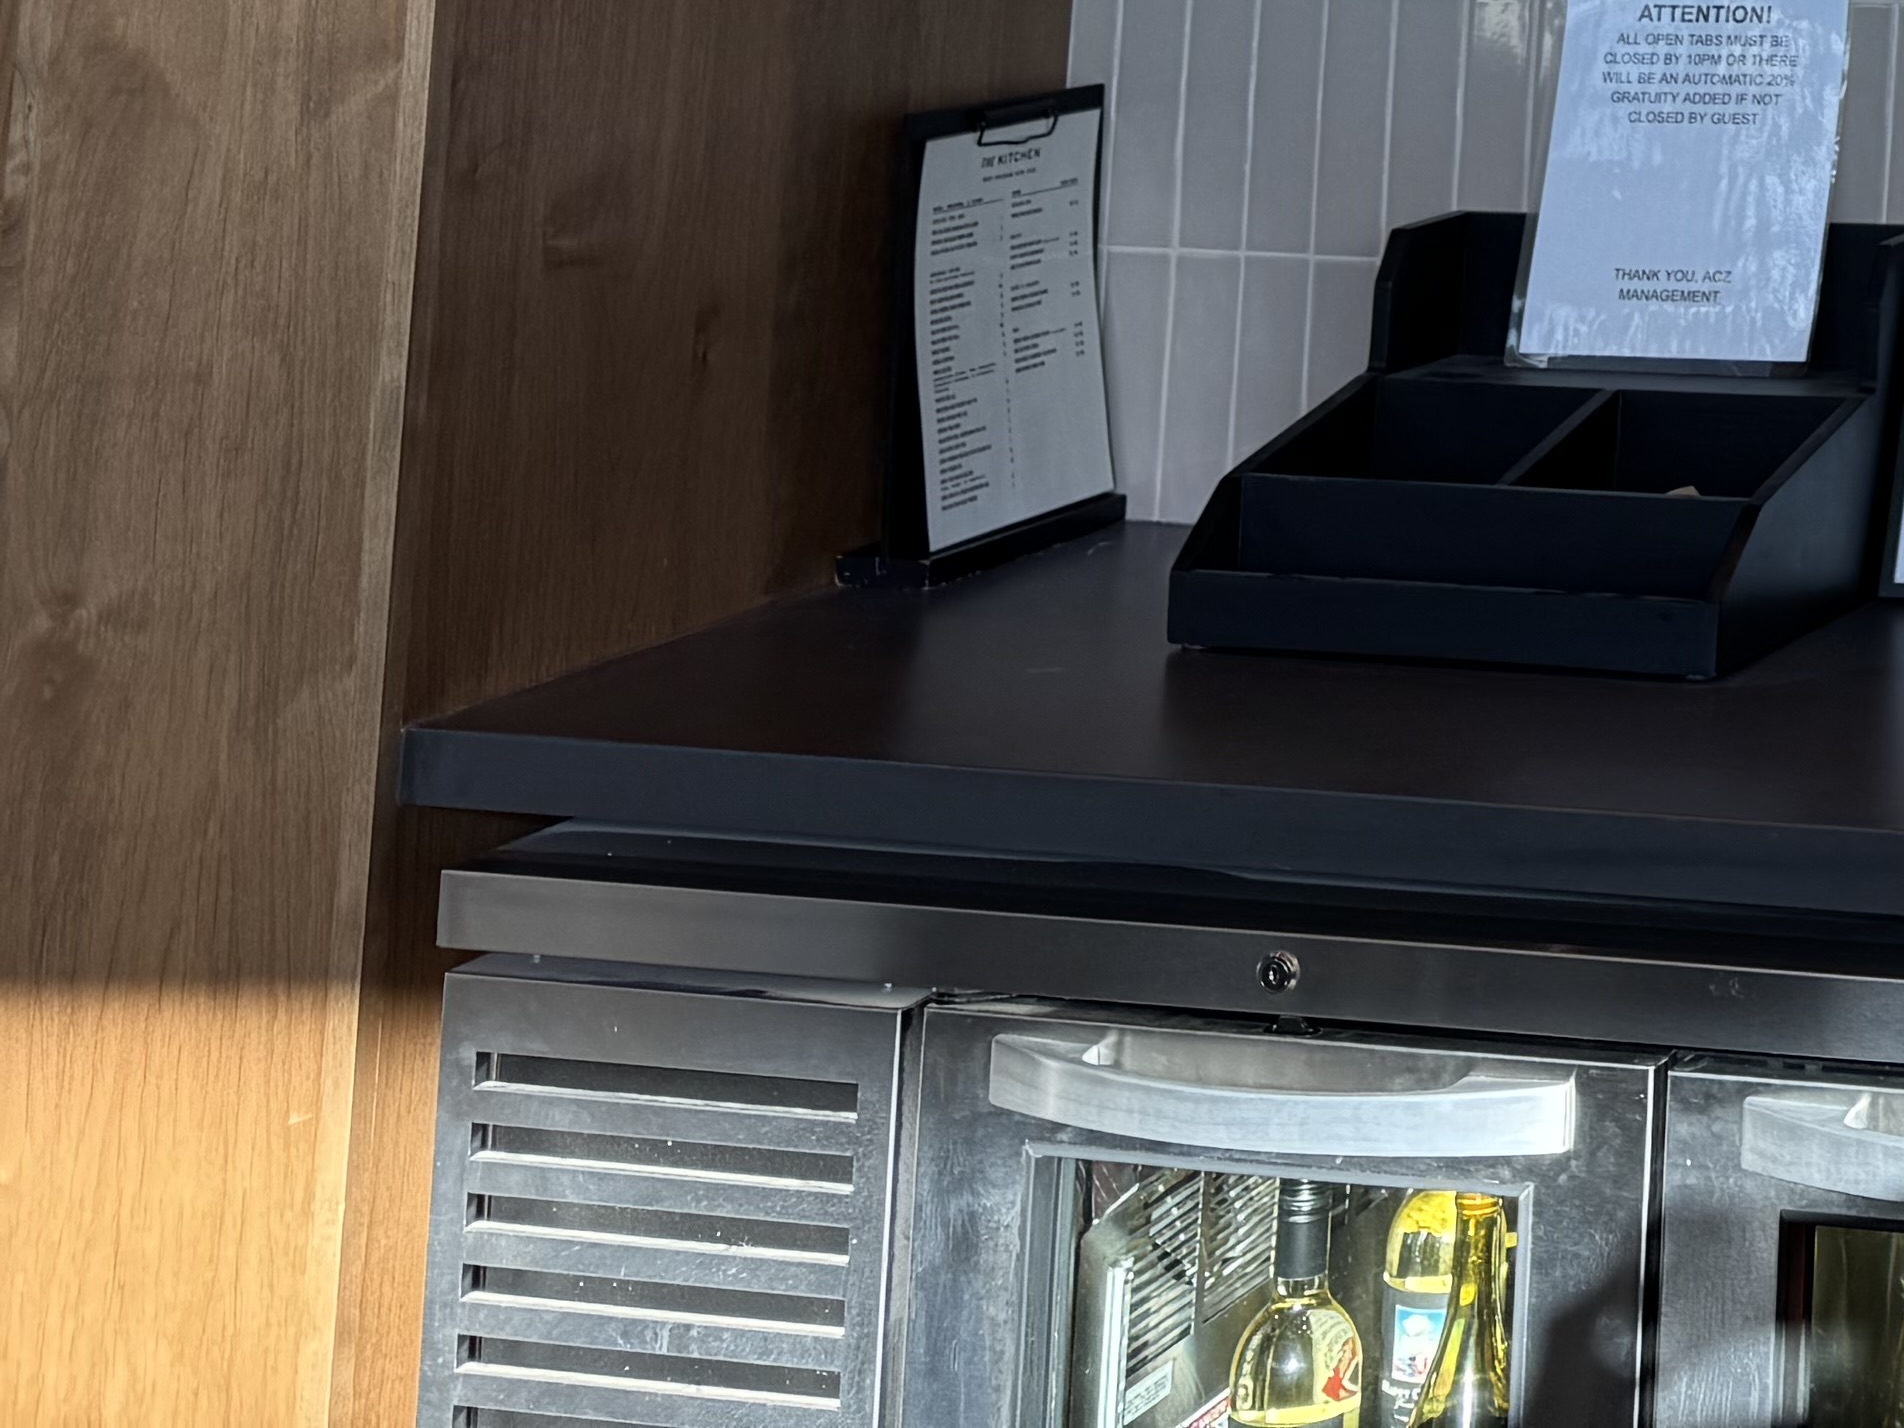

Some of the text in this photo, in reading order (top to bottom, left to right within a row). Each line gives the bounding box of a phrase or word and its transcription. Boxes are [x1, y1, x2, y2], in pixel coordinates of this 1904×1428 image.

[1638, 4, 1772, 24] ATTENTION!
[1616, 34, 1790, 48] ALL OPEN TABS MUST BE
[1604, 53, 1798, 68] CLOSED BY 10PM OR THERE
[1602, 72, 1795, 87] WILL BE AN AUTOMATIC 20%
[1610, 92, 1781, 106] GRATUITY ADDED IF NOT
[1628, 111, 1759, 125] CLOSED BY GUEST
[1614, 268, 1661, 281] THANK
[1701, 270, 1732, 283] ACZ
